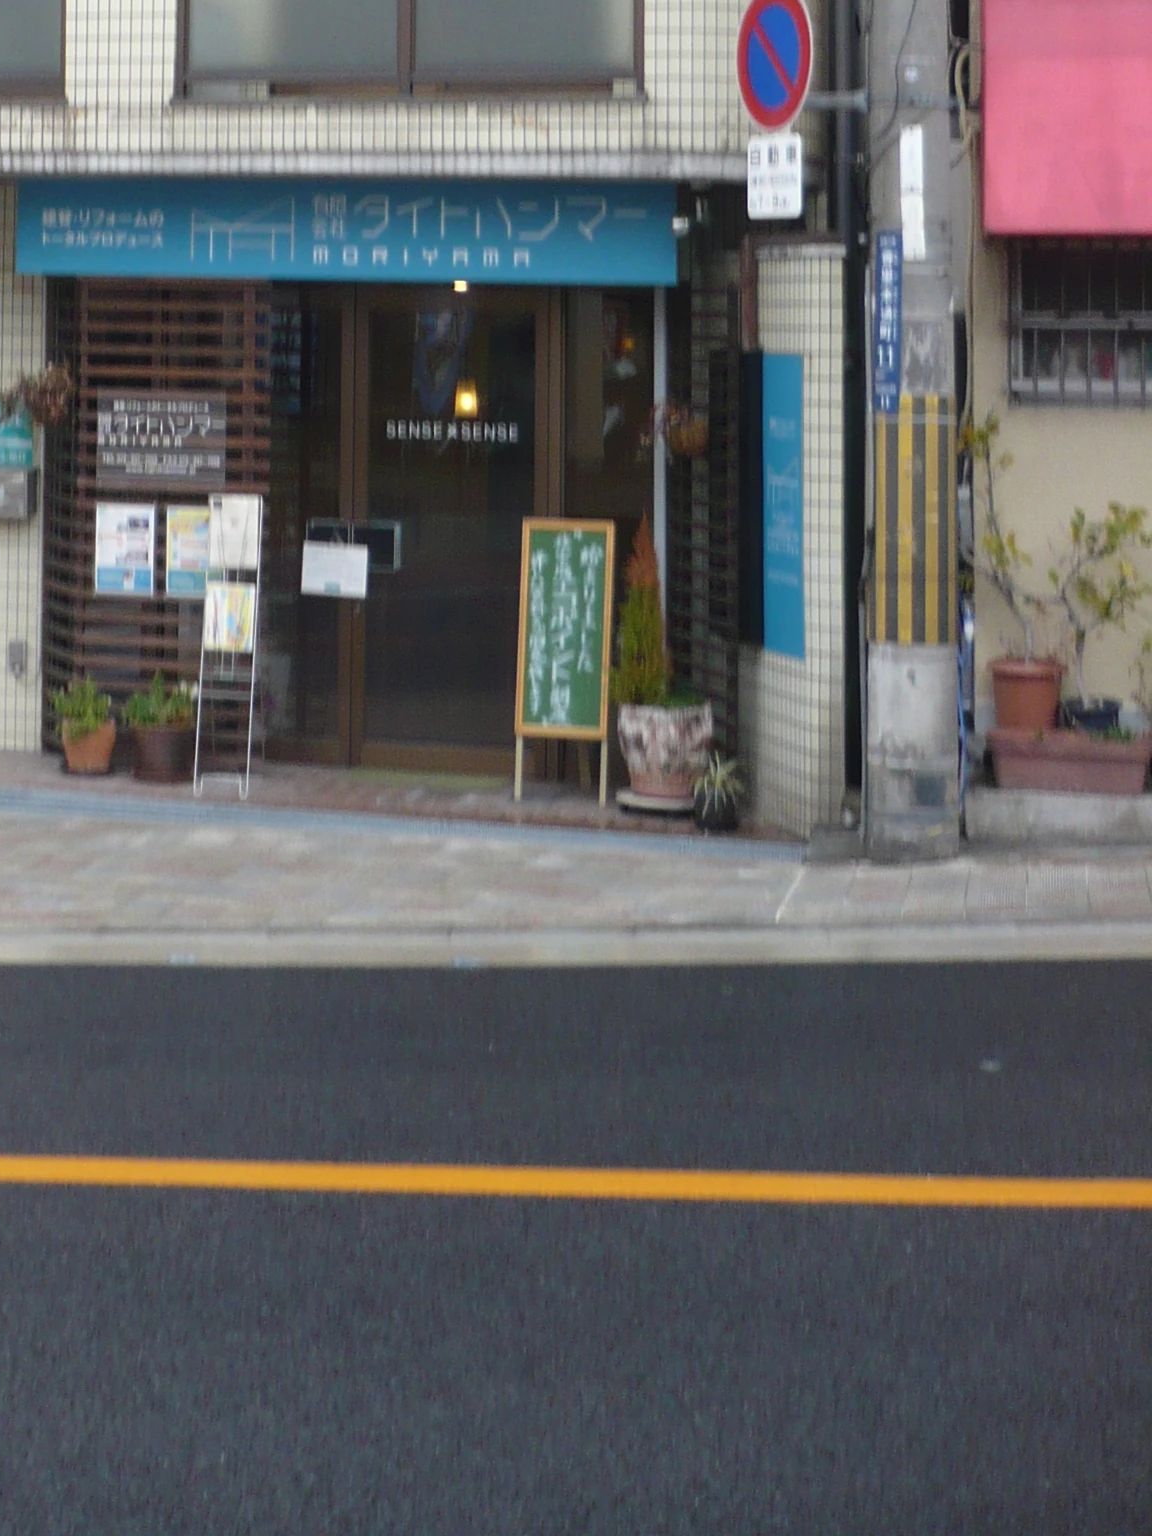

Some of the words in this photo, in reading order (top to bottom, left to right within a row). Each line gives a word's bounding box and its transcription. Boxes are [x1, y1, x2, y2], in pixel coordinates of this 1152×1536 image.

[750, 142, 797, 167] 自動車
[354, 194, 647, 242] タイトハンマー
[41, 230, 164, 249] トータルプロデュース
[312, 245, 531, 268] MORIYAMA
